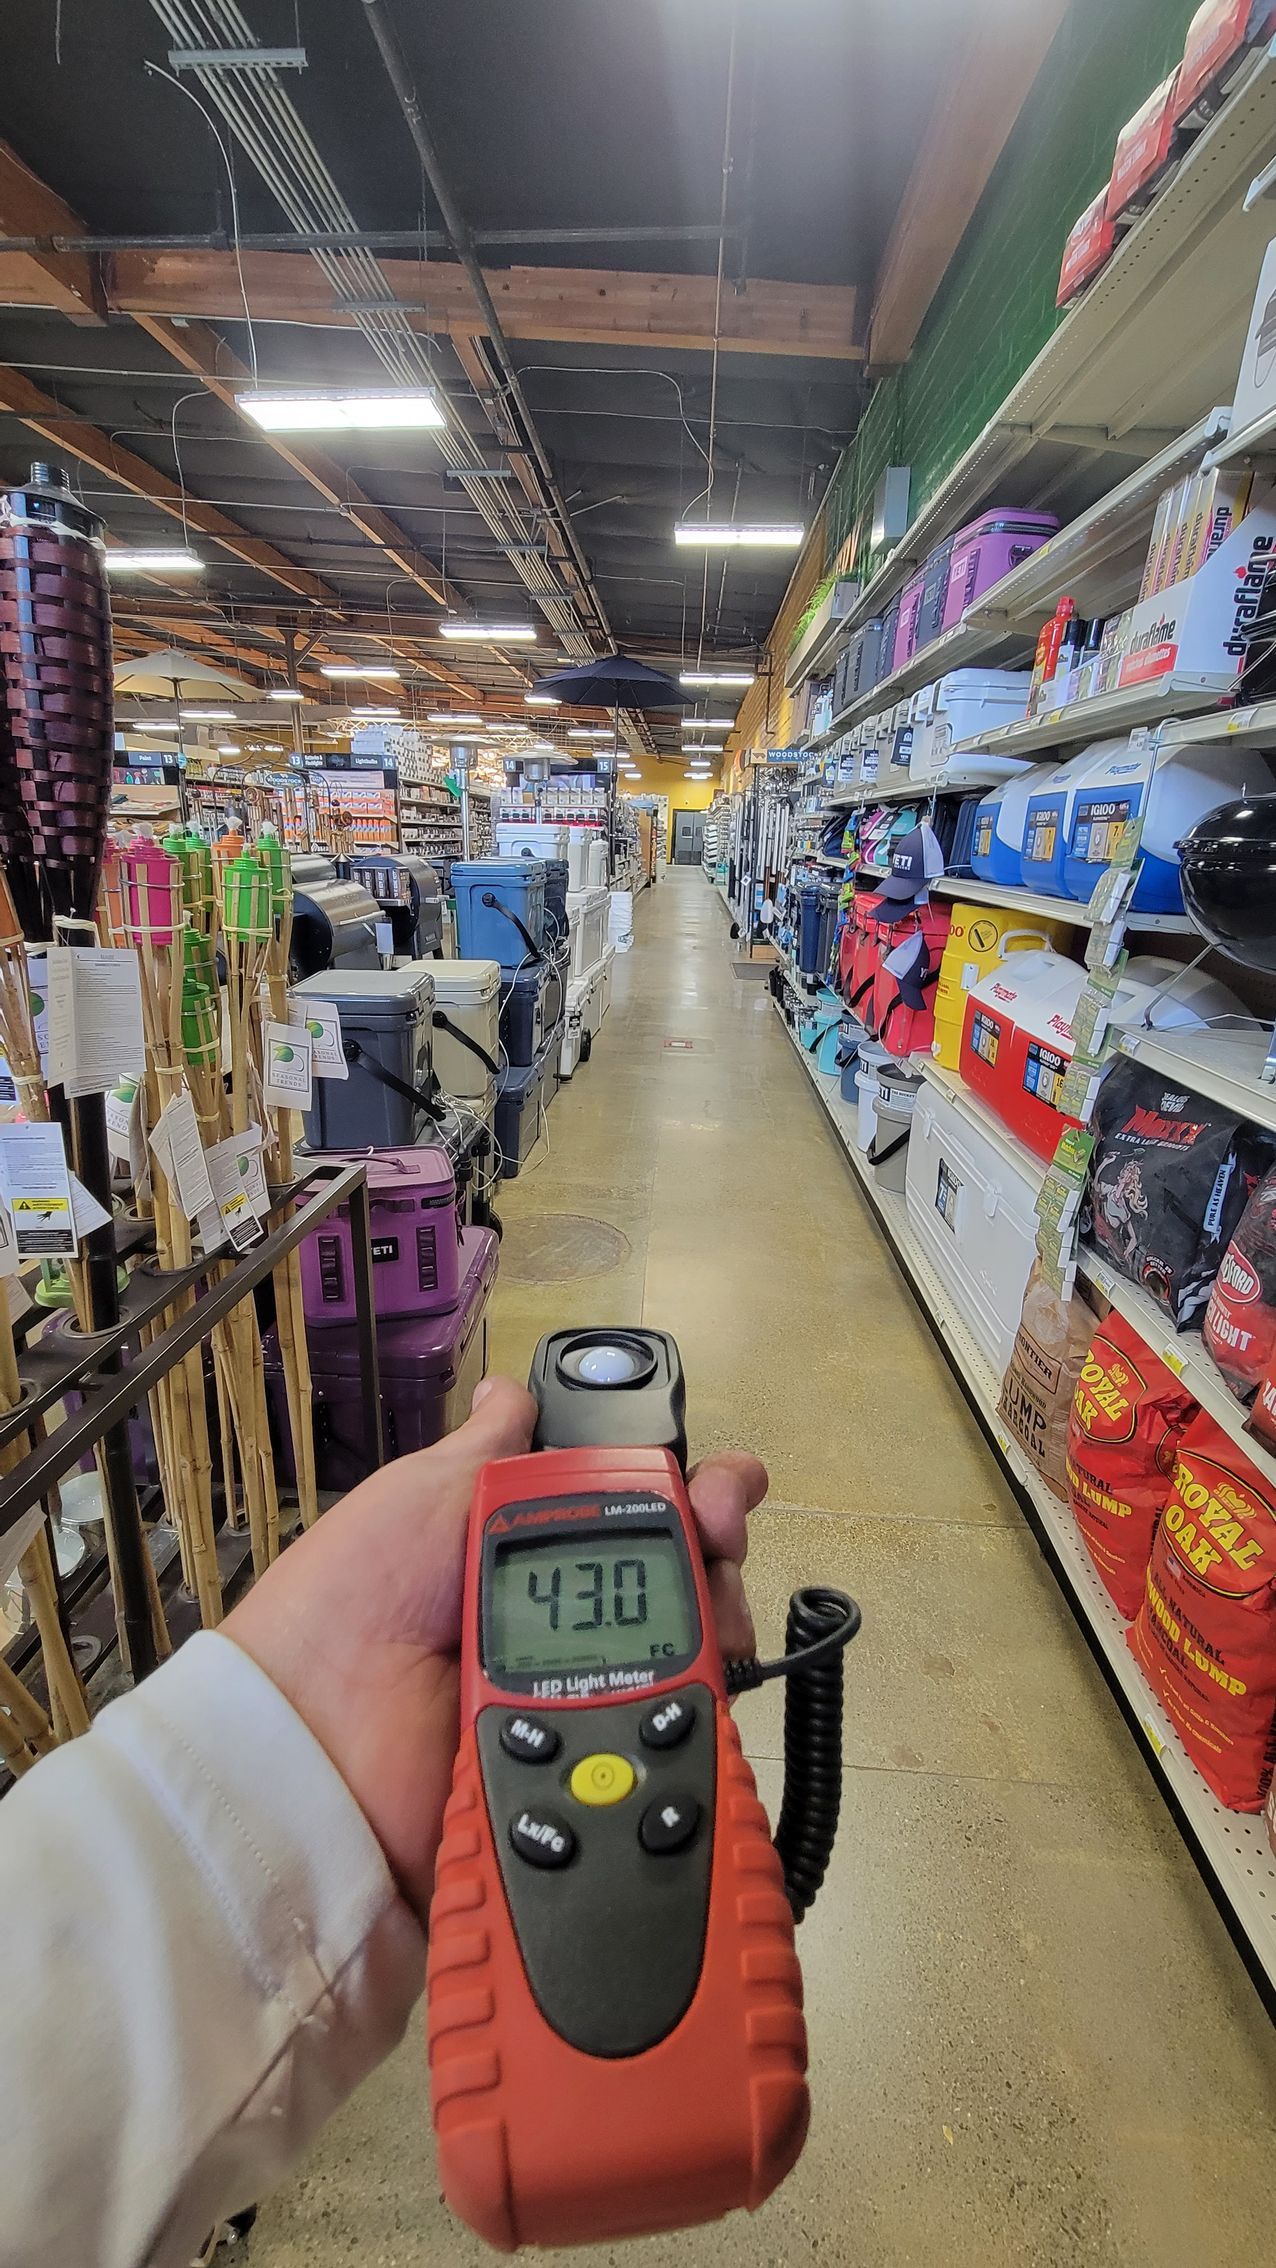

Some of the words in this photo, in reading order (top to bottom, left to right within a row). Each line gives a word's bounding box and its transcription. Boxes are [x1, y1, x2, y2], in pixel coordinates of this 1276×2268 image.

[1129, 619, 1176, 656] duraflame
[163, 754, 173, 764] 13
[290, 756, 300, 765] 13
[383, 757, 393, 767] 14
[505, 760, 514, 770] 14
[599, 761, 608, 771] 15
[1090, 803, 1116, 816] IGLOO
[1039, 1047, 1060, 1067] IGLOO
[271, 1072, 306, 1083] SEASONAL
[276, 1078, 302, 1088] TRENDS
[1114, 1132, 1140, 1145] EXTRA
[1215, 1169, 1227, 1197] HEAVEN
[1213, 1197, 1220, 1207] AS
[1207, 1207, 1218, 1226] PURE
[371, 1245, 393, 1256] ETI
[1212, 1312, 1253, 1352] LIGHT
[604, 1502, 666, 1517] LM-200LED
[1082, 1482, 1132, 1518] LUMP
[1172, 1462, 1265, 1571] ROYAL
[1164, 1504, 1223, 1577] OAK
[528, 1559, 648, 1632] 43.0
[1168, 1599, 1225, 1667] NATURAL
[650, 1642, 675, 1657] FC
[1183, 1638, 1247, 1697] LUMP
[532, 1678, 562, 1694] LED
[566, 1674, 606, 1692] Light
[609, 1670, 655, 1686] Meter
[652, 1702, 683, 1732] D-H
[510, 1719, 545, 1748] M-H
[661, 1806, 681, 1828] R
